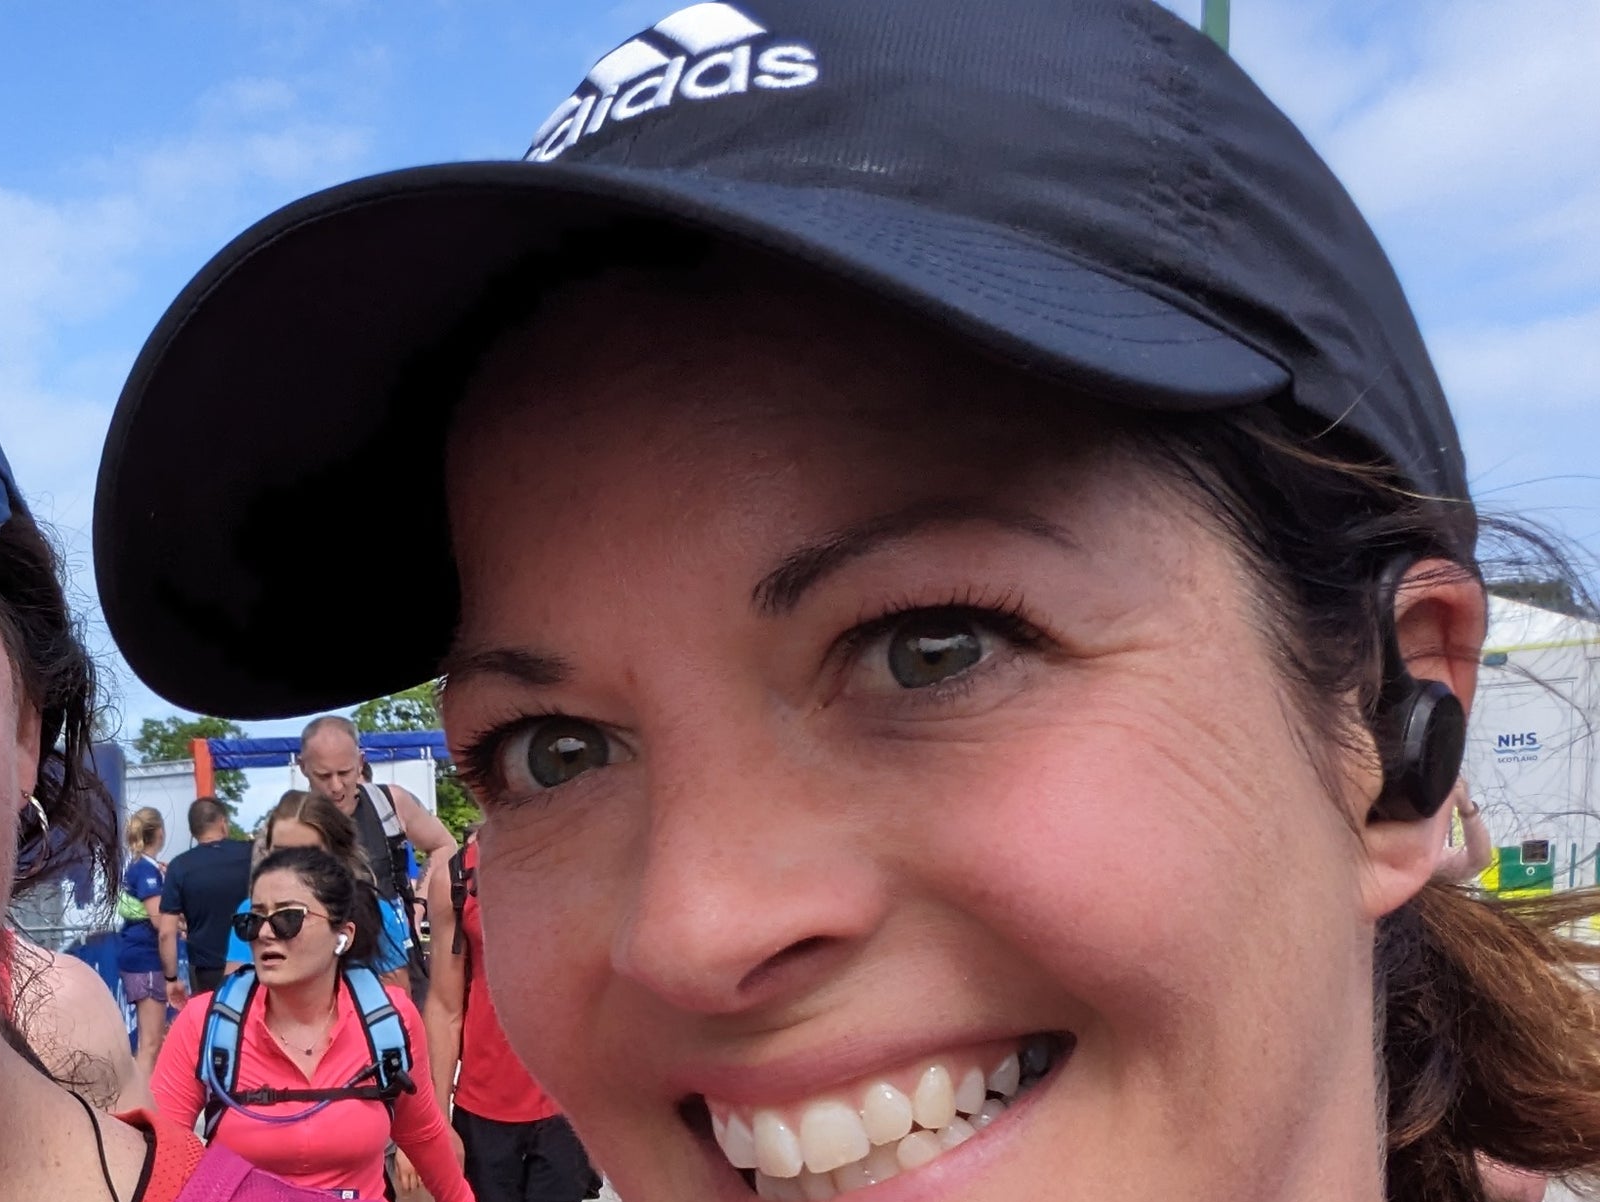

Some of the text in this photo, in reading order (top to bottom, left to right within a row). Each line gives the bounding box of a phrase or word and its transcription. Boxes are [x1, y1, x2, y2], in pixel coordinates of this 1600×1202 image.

[524, 44, 819, 162] didas
[1498, 732, 1538, 747] NHS
[1497, 755, 1539, 763] SCOTLAND
